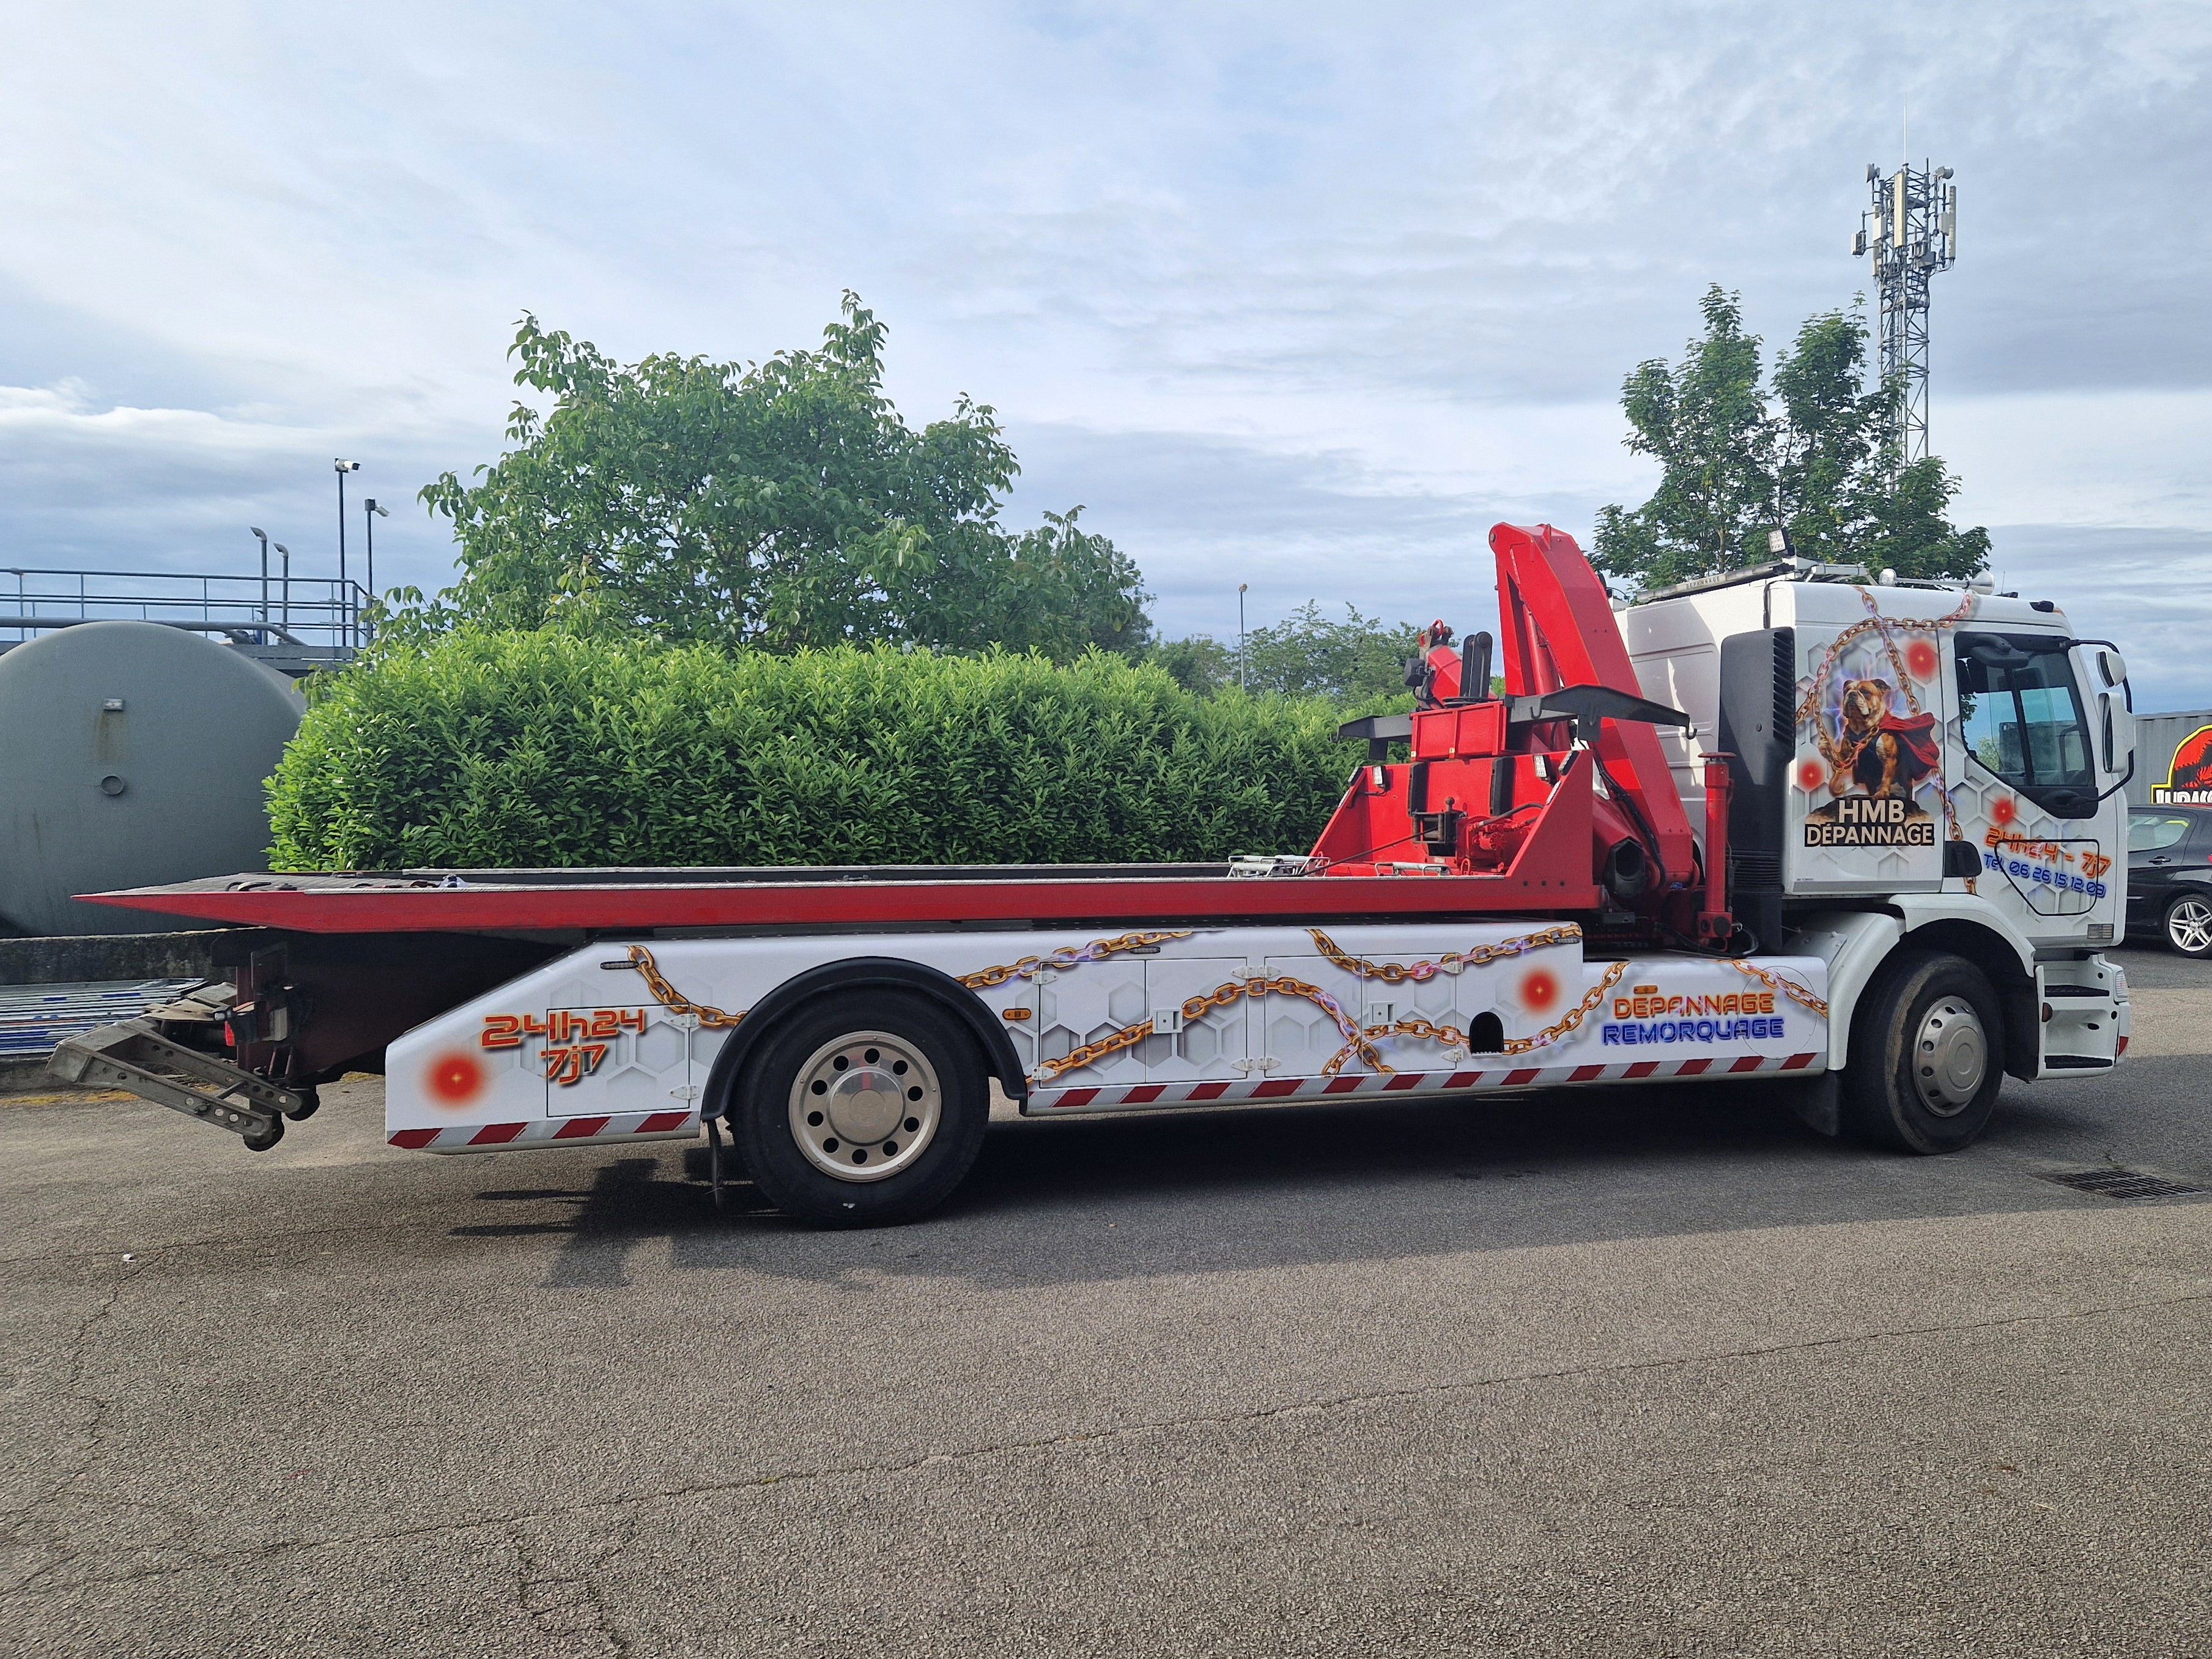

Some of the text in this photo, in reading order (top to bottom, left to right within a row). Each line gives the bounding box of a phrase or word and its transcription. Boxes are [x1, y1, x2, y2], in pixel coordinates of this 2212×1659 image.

[1839, 800, 1904, 823] HMB
[1807, 823, 1933, 845] DÉPANNAGE
[2010, 861, 2029, 875] 06
[2032, 867, 2051, 881] 26
[2054, 872, 2067, 886] 15
[2071, 877, 2083, 889] 12
[481, 1009, 644, 1047] 24h24
[1604, 1018, 1784, 1044] REMORQUAGE
